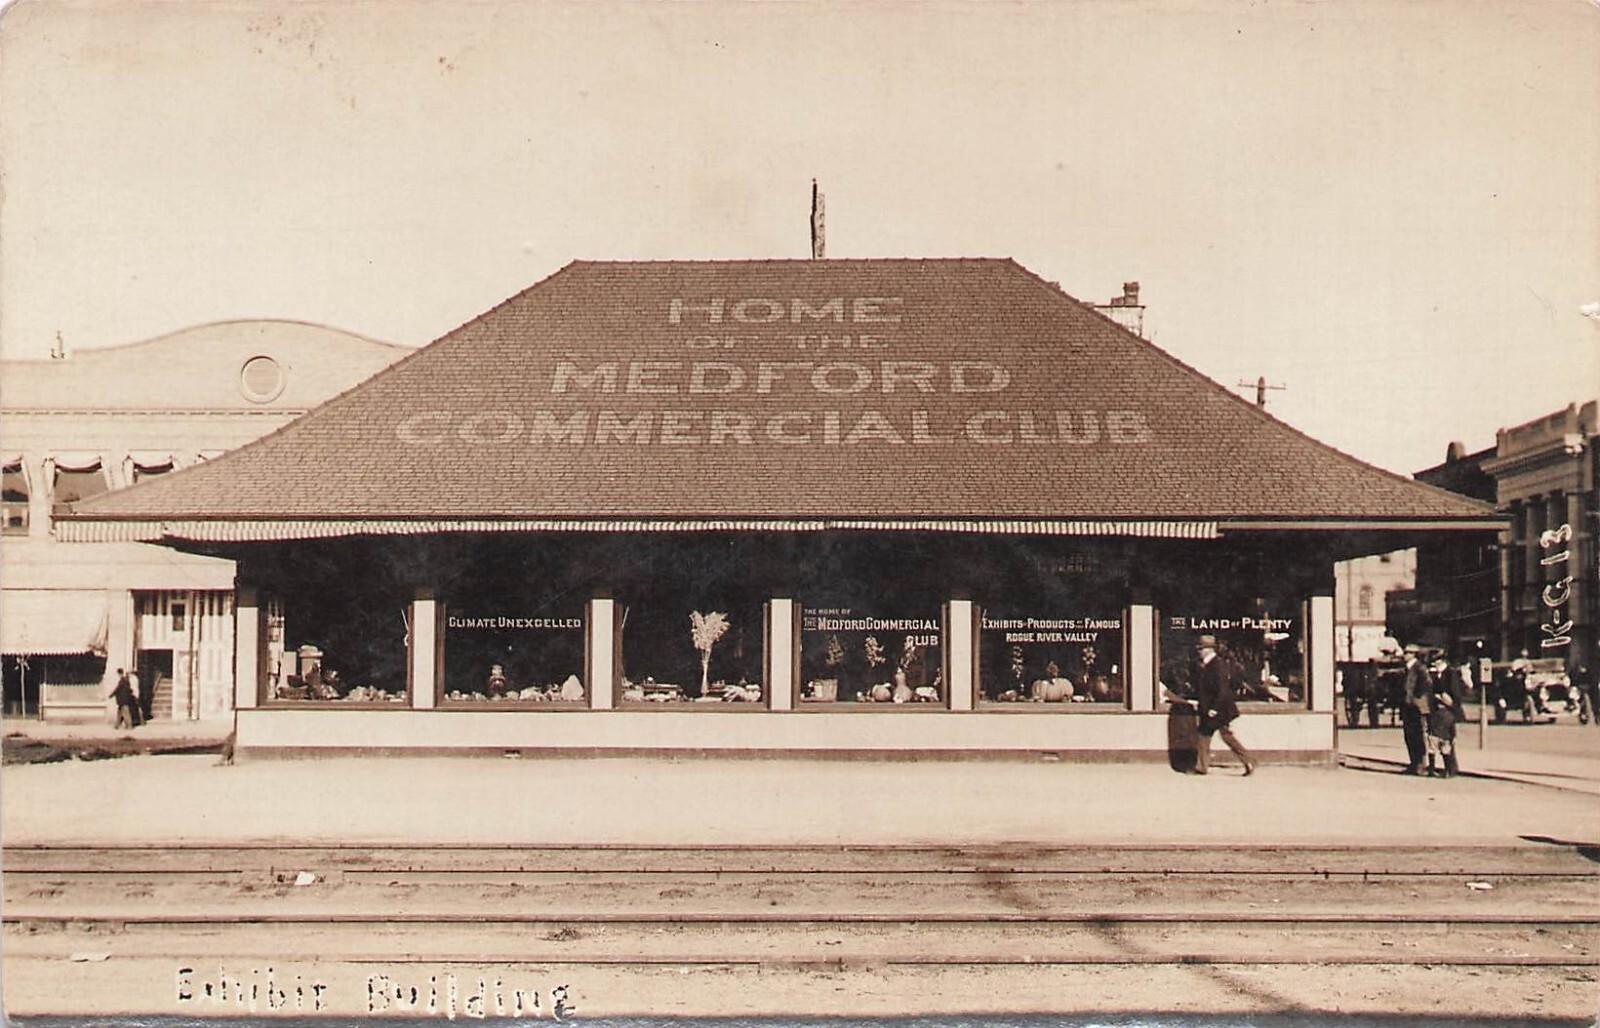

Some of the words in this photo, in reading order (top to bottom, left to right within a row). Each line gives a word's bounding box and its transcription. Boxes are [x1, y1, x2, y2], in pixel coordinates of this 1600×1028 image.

[668, 297, 904, 325] HOME
[795, 335, 890, 348] THE
[551, 360, 1011, 394] MEDFORD
[395, 409, 953, 445] COMMERCIAL
[964, 409, 1151, 445] CLUB
[449, 616, 496, 629] CLIMATE
[498, 616, 581, 629] UNEXCELLED
[818, 617, 866, 631] MEDFORD
[866, 617, 940, 631] COMMERCIAL
[1027, 617, 1075, 630] PRODUCTS
[1084, 617, 1121, 630] FAMOUS
[1191, 617, 1230, 630] LAND
[1242, 617, 1292, 630] PLENTY
[906, 635, 939, 646] CLUB
[1006, 632, 1034, 642] ROGUE
[1037, 632, 1063, 642] RIVER
[1064, 632, 1098, 642] VALLEY
